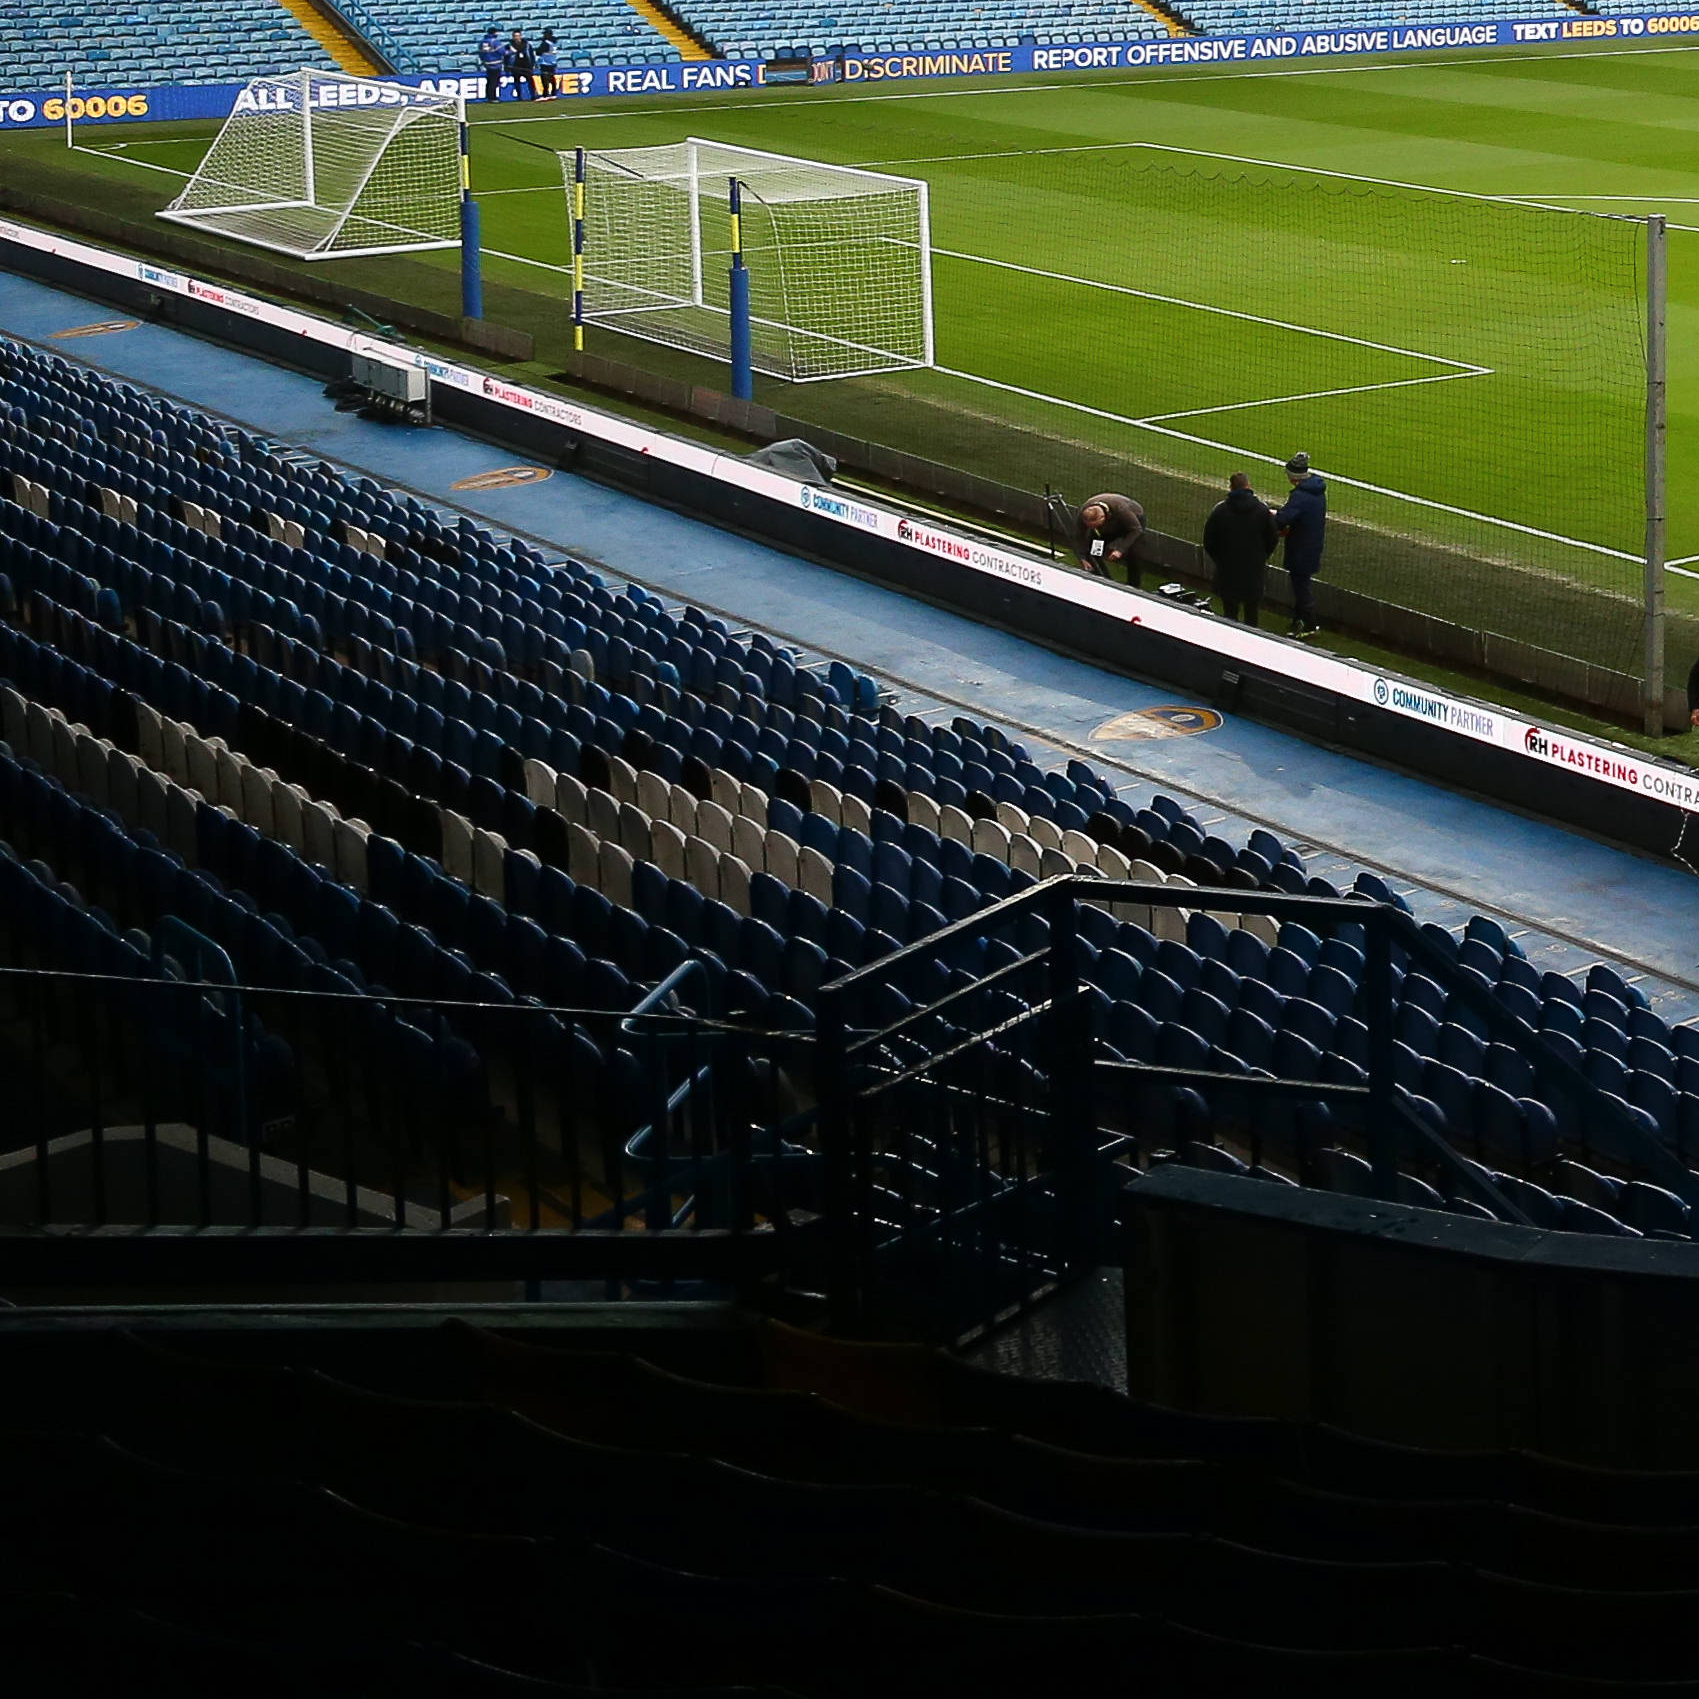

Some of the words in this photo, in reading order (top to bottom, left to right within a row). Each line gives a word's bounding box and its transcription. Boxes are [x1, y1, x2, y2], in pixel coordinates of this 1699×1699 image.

[1034, 46, 1119, 70] REPORT
[1127, 40, 1245, 67] OFFENSIVE
[1251, 37, 1297, 57] AND
[1302, 32, 1386, 54] ABUSIVE
[1392, 24, 1497, 48] LANGUAGE
[1513, 22, 1558, 41] TEXT
[1562, 19, 1617, 38] LEEDS
[1620, 19, 1642, 36] TO
[236, 86, 293, 111] ALL
[309, 80, 408, 110] LEEDS,
[608, 70, 675, 93] REAL
[682, 64, 753, 89] FANS
[0, 100, 35, 123] TO
[42, 95, 149, 120] 60006
[915, 532, 969, 560] PLASTERING
[972, 552, 1041, 585] CONTRACTORS
[1393, 688, 1448, 721] COMMUNITY
[1451, 707, 1494, 737] PARTNER
[1526, 730, 1548, 757] RH
[1551, 744, 1638, 784] PLASTERING
